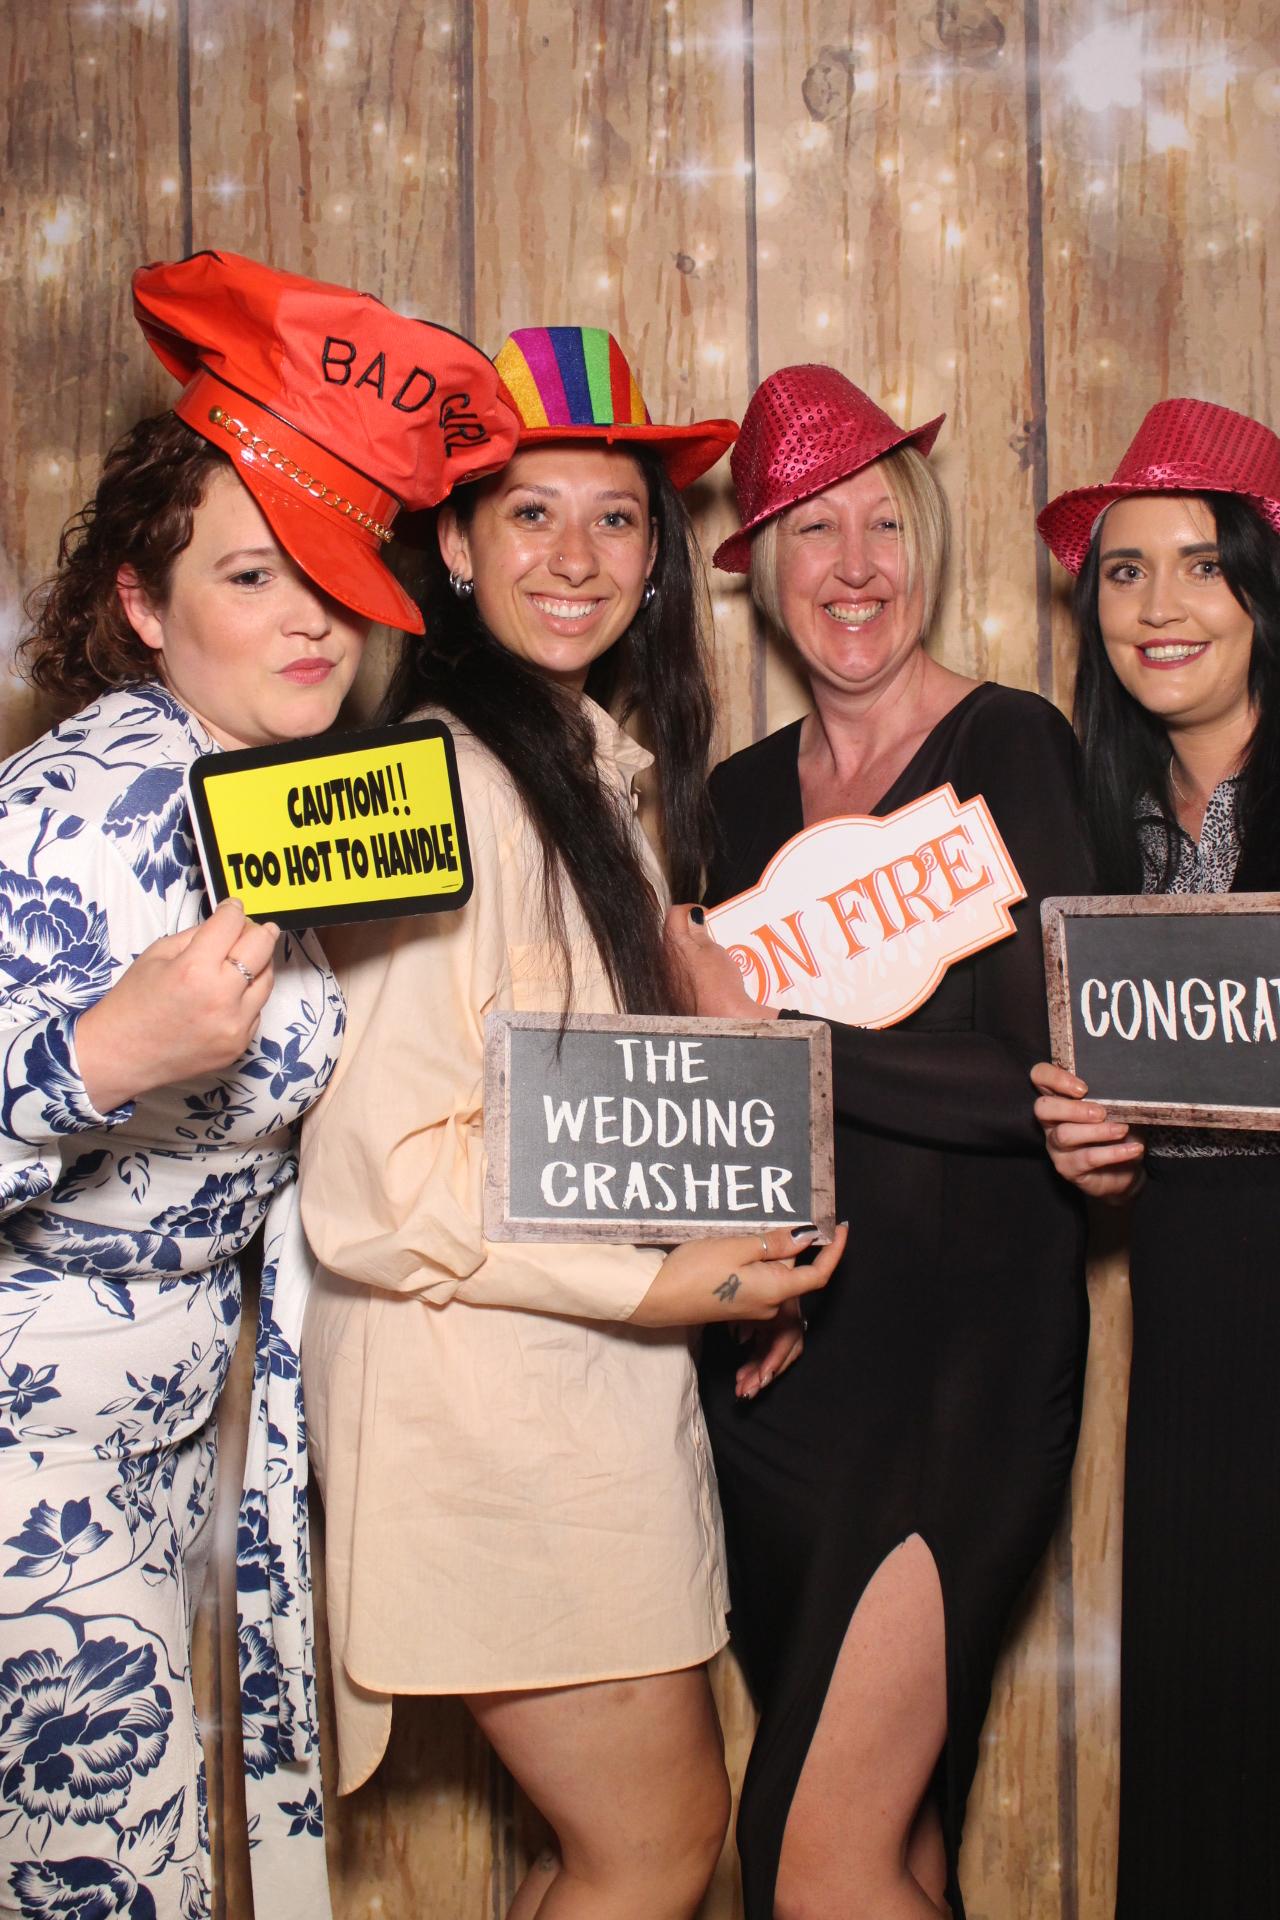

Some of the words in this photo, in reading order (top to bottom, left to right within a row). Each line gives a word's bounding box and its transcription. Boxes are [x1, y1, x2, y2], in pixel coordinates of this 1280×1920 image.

[322, 336, 437, 413] BAD
[439, 393, 491, 458] GIRL
[287, 762, 411, 829] CAUTION!!
[227, 850, 281, 890] TOO
[283, 840, 333, 887] HOT
[335, 836, 369, 881] TO
[370, 822, 458, 879] HANDLE
[815, 824, 994, 960] FIRE
[614, 1039, 709, 1084] THE
[543, 1095, 775, 1148] WEDDING
[540, 1161, 796, 1213] CRASHER
